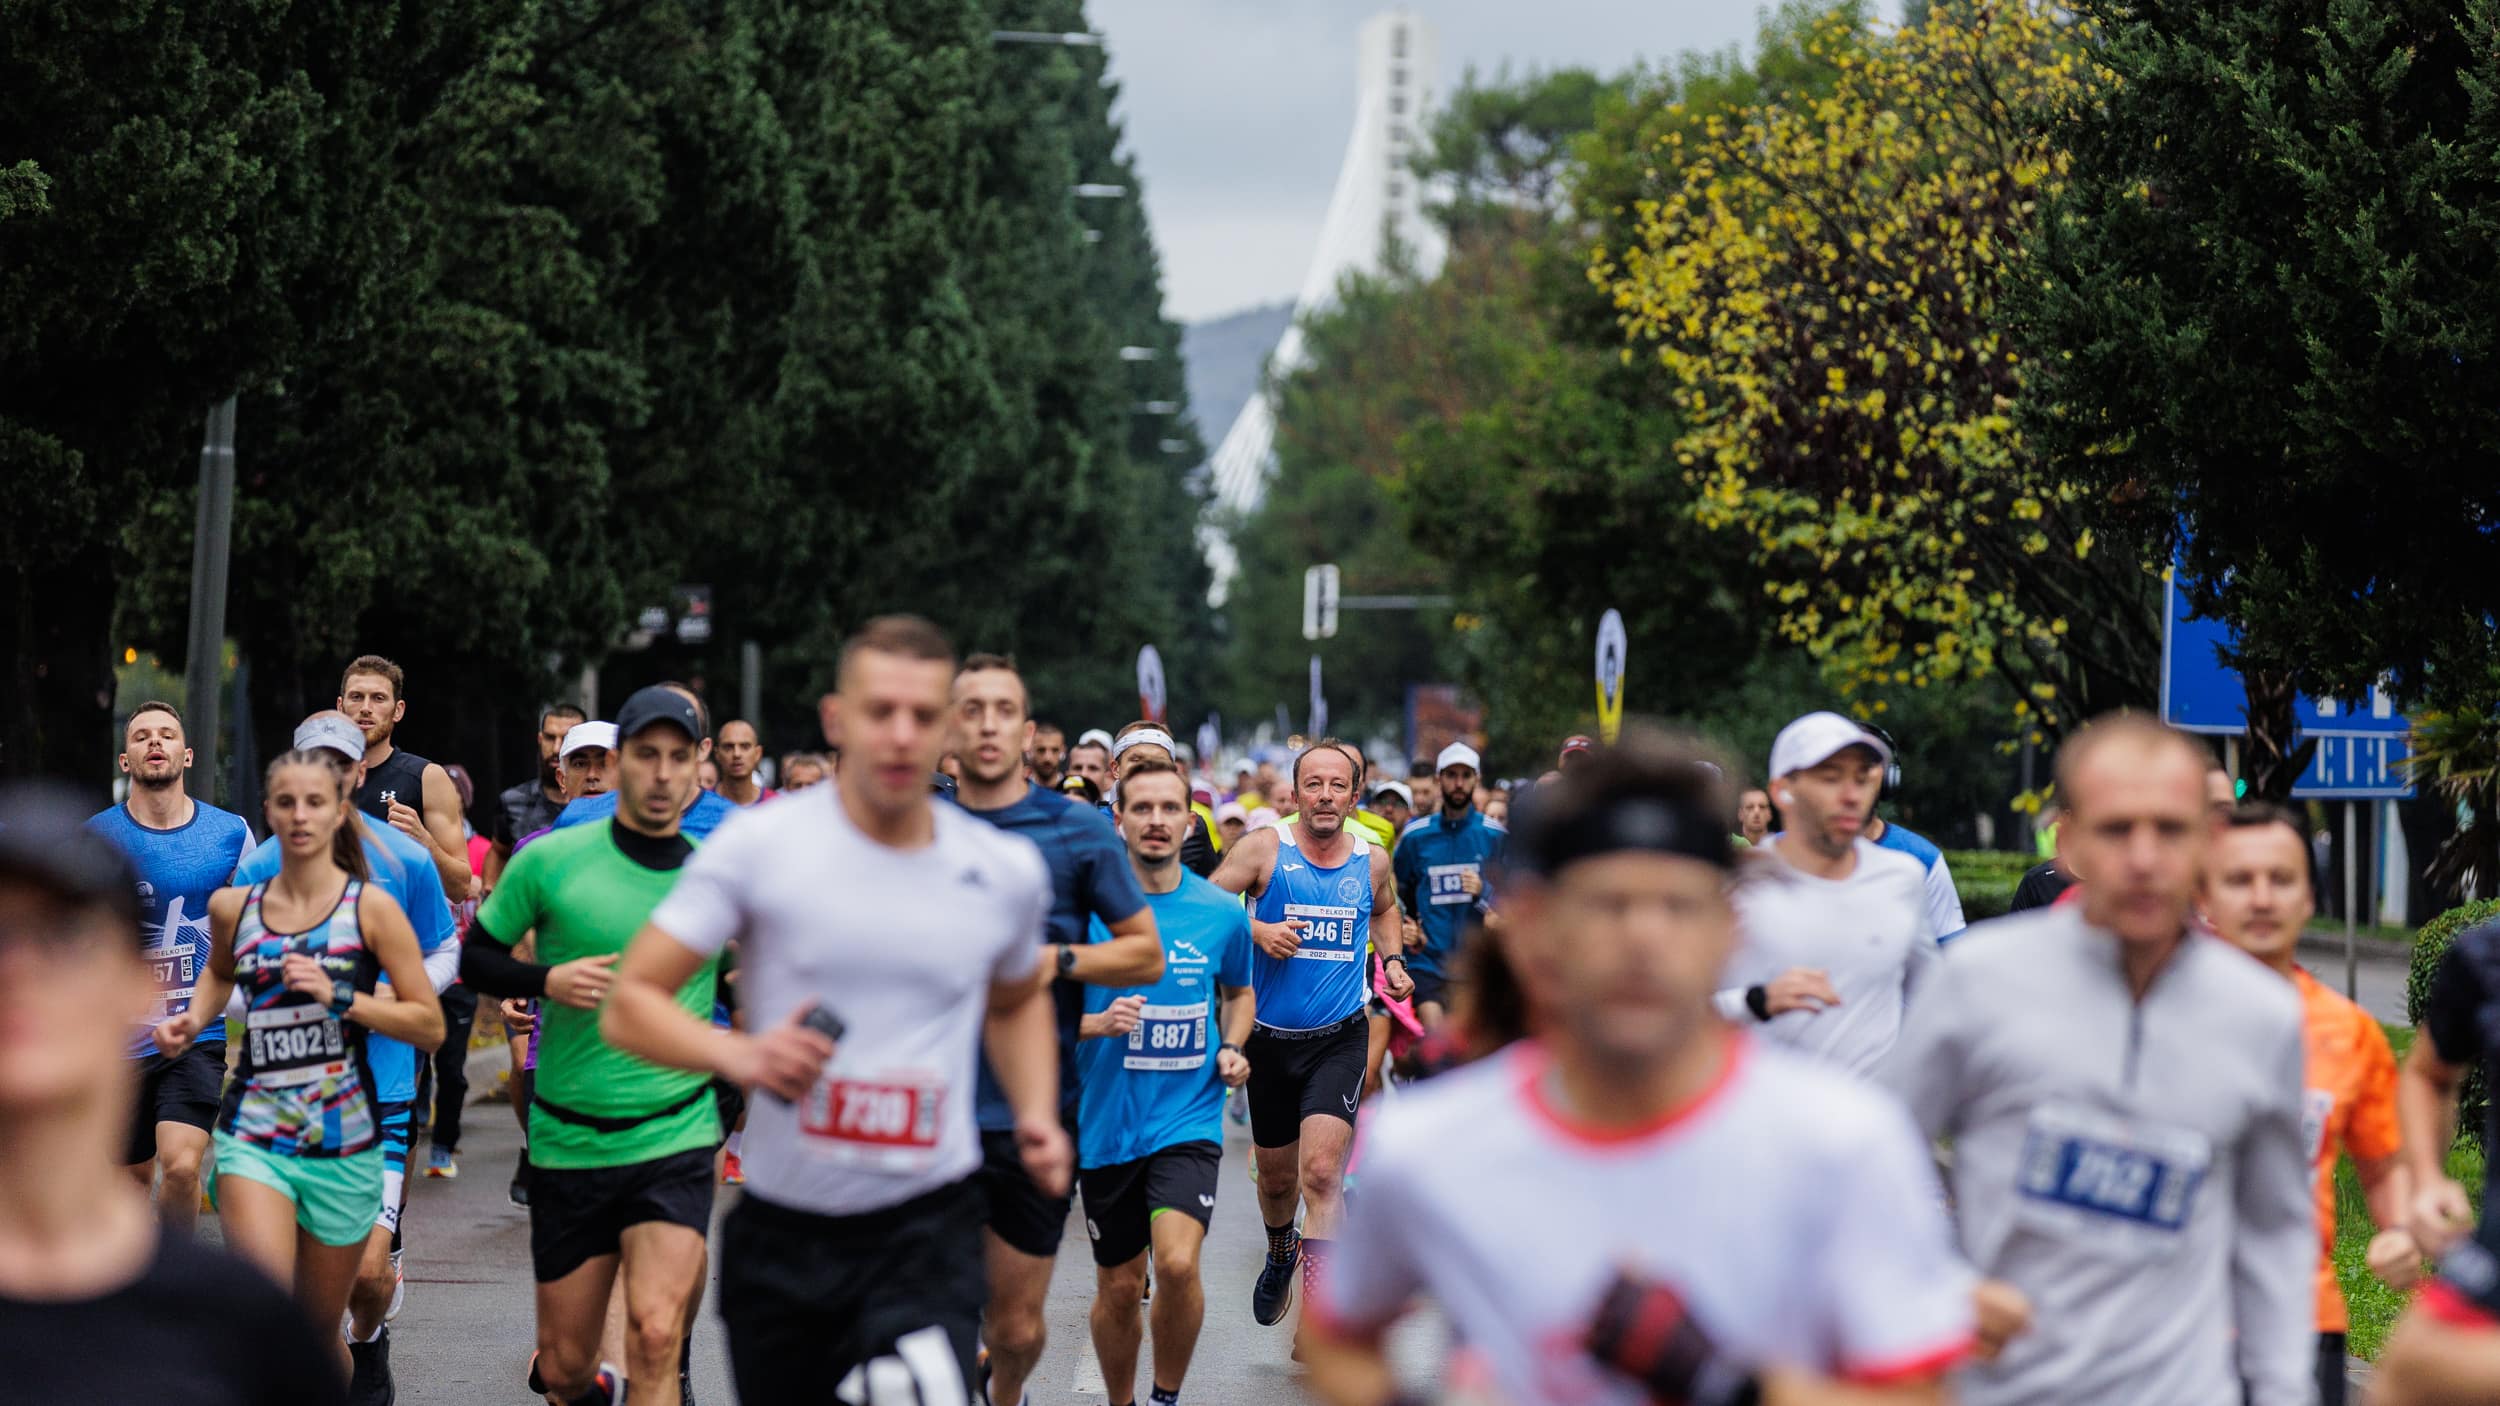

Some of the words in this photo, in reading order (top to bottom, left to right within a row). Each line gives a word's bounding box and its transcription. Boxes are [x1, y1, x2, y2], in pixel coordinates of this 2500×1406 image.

[1302, 920, 1338, 942] 946
[1309, 951, 1327, 959] 2022
[148, 961, 174, 984] 57
[264, 1024, 324, 1062] 1302
[1151, 1023, 1191, 1049] 887
